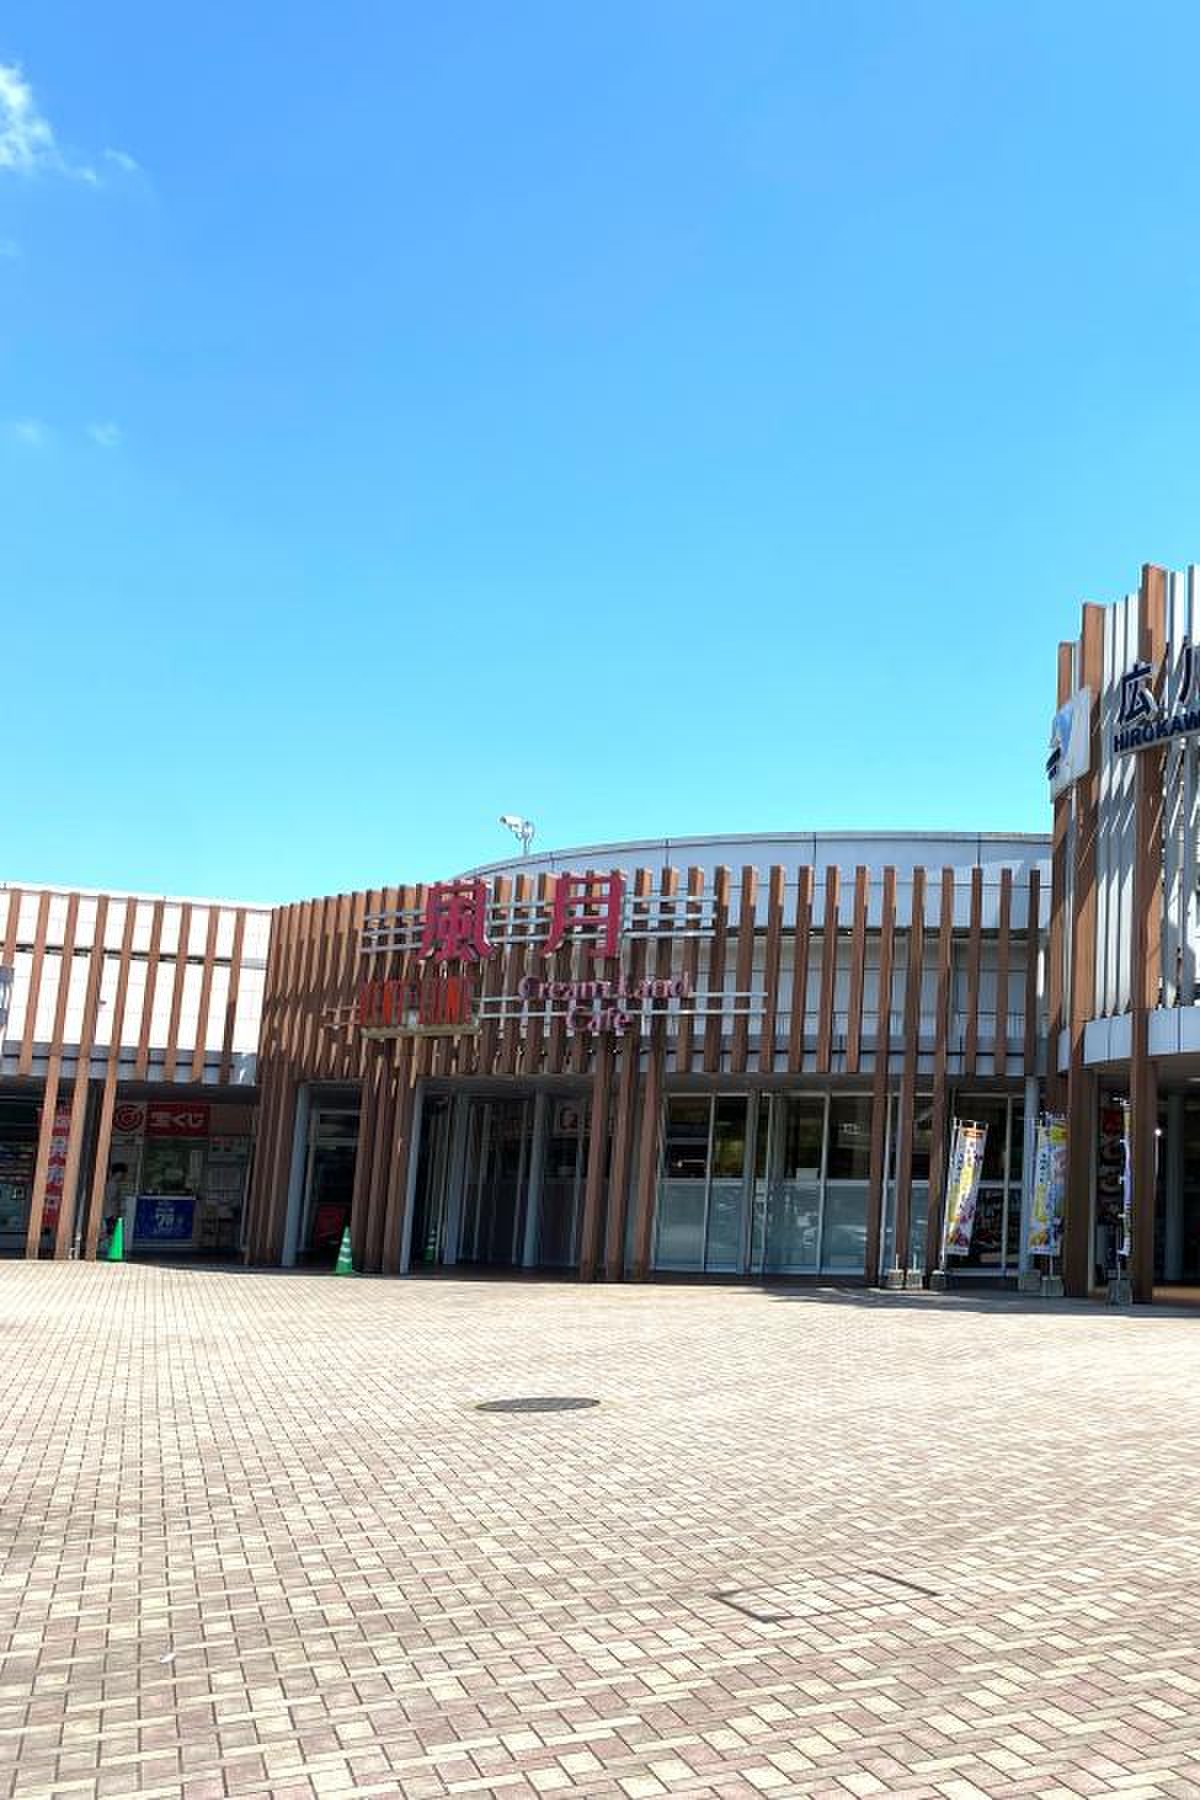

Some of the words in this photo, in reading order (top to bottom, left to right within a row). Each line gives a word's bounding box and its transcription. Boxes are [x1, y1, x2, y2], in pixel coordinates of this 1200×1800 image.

[418, 870, 627, 961] 風月
[518, 976, 613, 1000] Cream
[617, 970, 691, 999] Land
